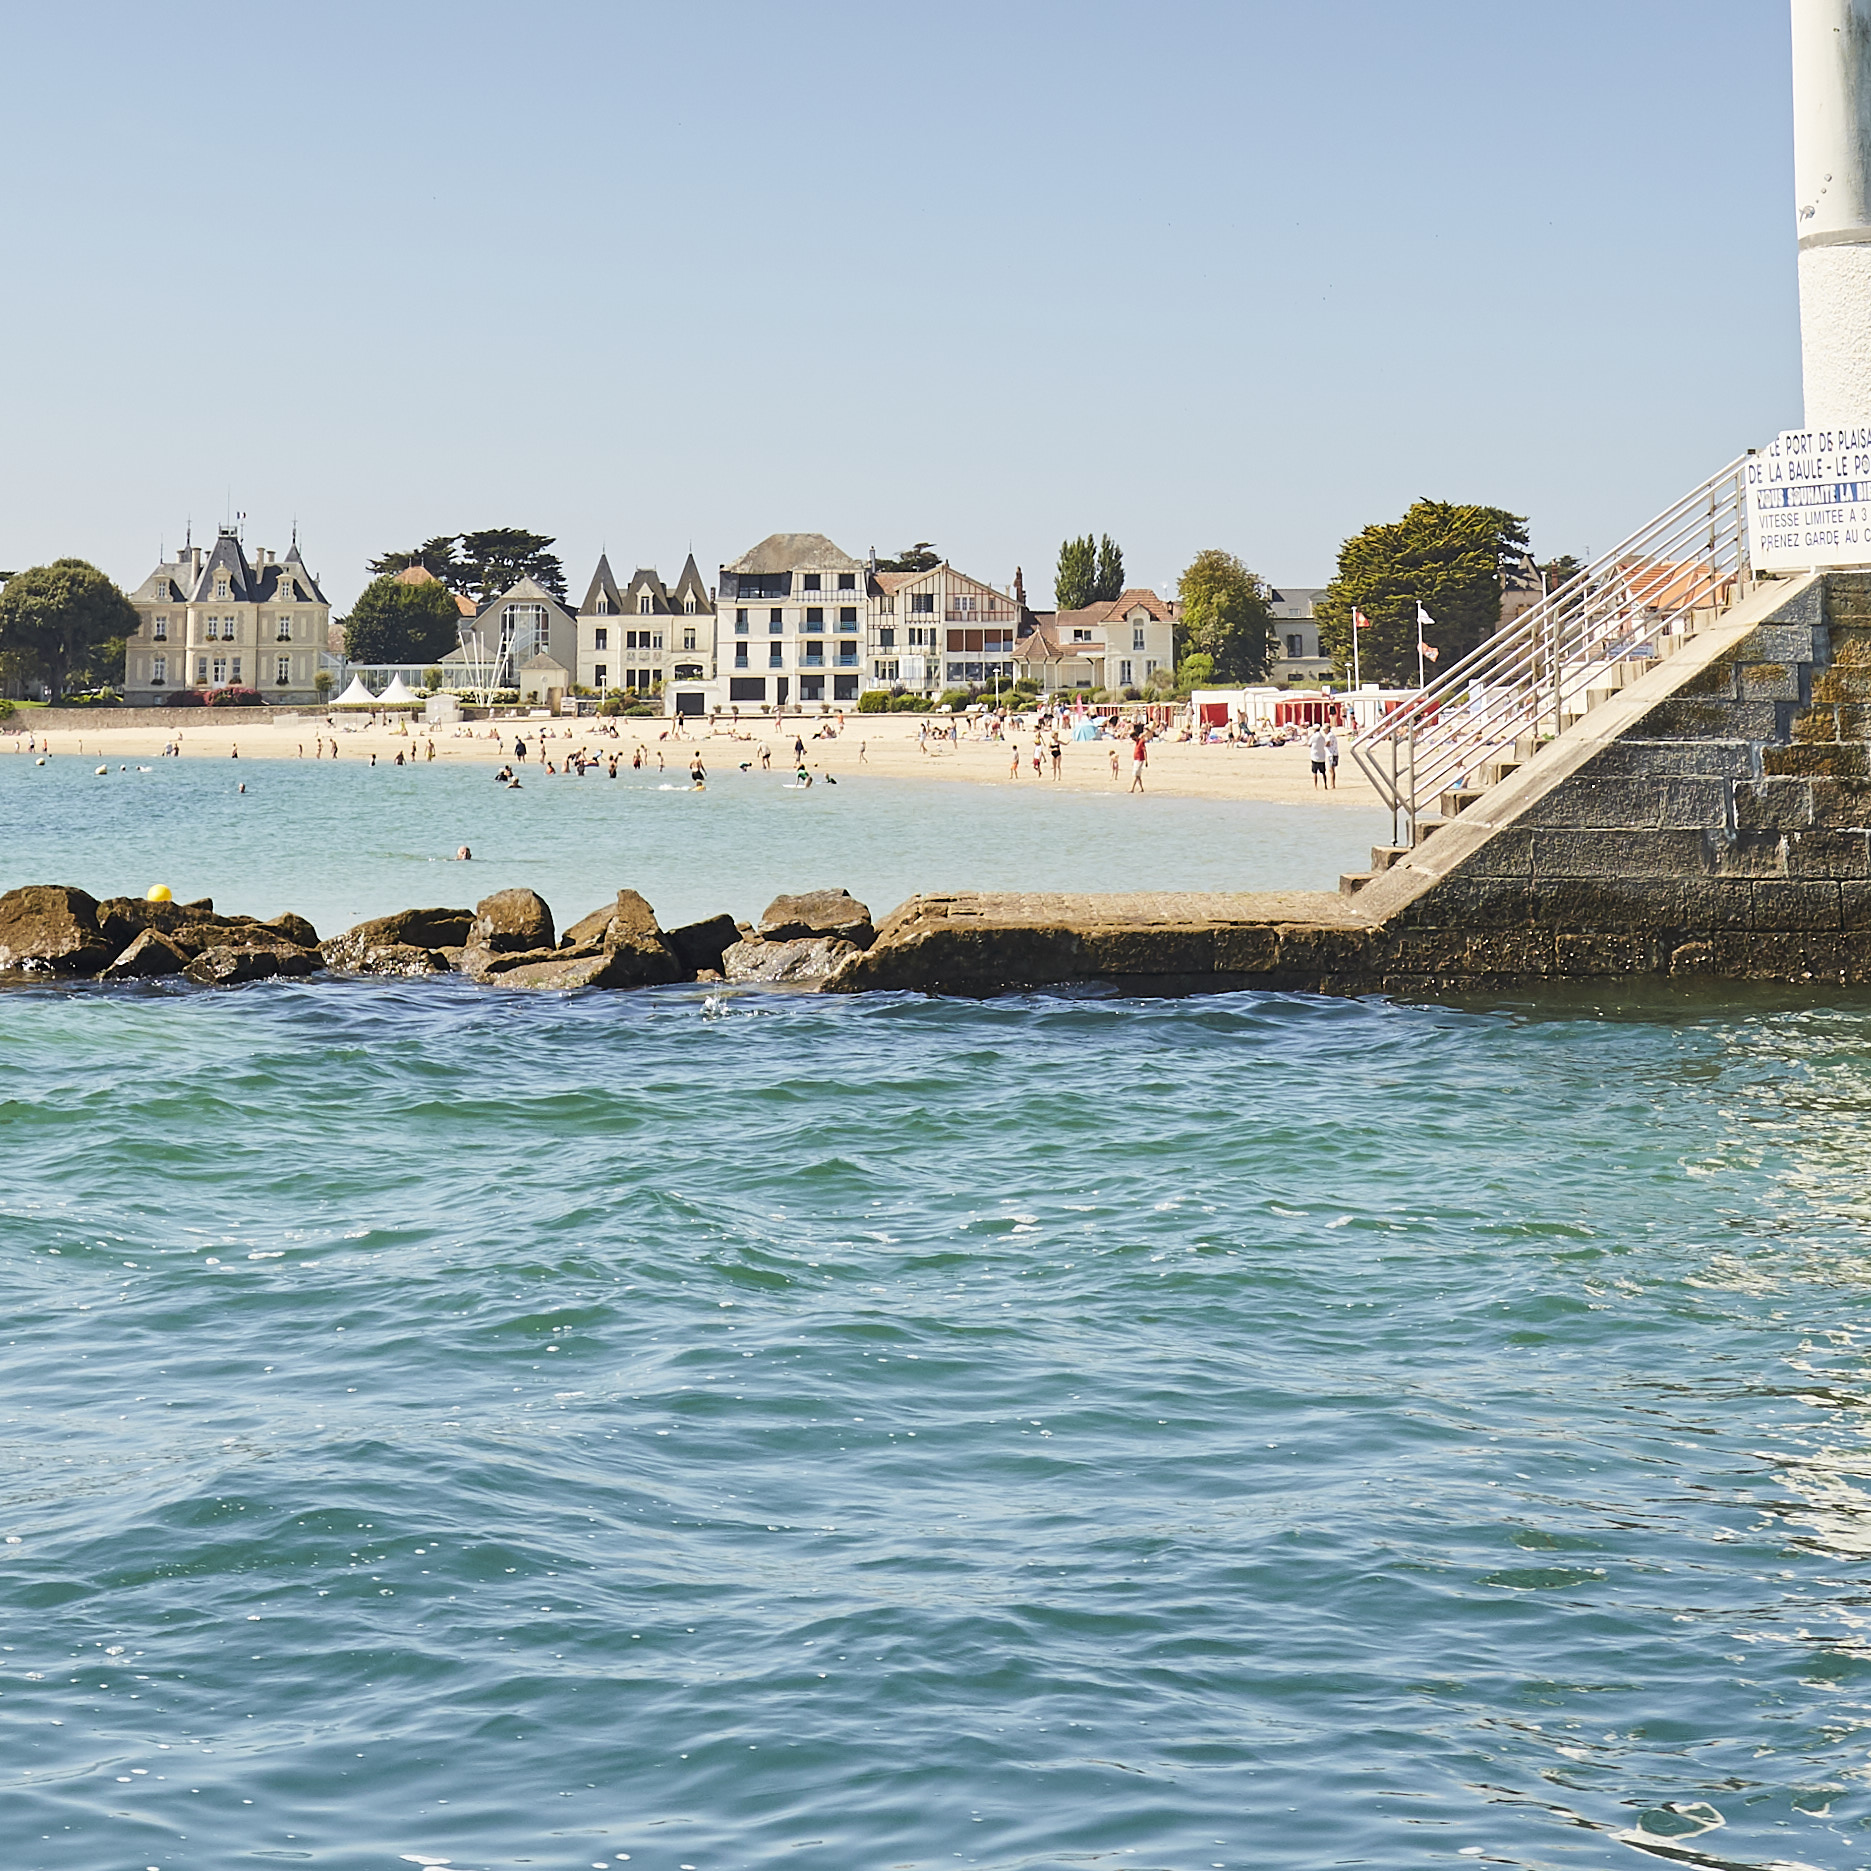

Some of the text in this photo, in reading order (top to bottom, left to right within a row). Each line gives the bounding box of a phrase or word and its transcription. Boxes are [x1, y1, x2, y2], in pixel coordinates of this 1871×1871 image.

[1770, 438, 1780, 457] LE
[1786, 433, 1812, 456] PORT
[1819, 431, 1833, 452] DE
[1748, 464, 1763, 484] DE
[1769, 463, 1782, 482] LA
[1789, 458, 1823, 481] BAULE
[1836, 456, 1848, 476] LE
[1757, 489, 1784, 508] VOUS
[1787, 484, 1836, 507] SOUHAITE
[1839, 483, 1853, 502] LA
[1759, 512, 1799, 528] VITESSE
[1805, 509, 1843, 526] LIMITEE
[1849, 508, 1857, 522] A
[1861, 507, 1867, 521] 3
[1761, 533, 1799, 549] PRENEZ
[1805, 530, 1839, 546] GARDE
[1845, 529, 1858, 543] AU
